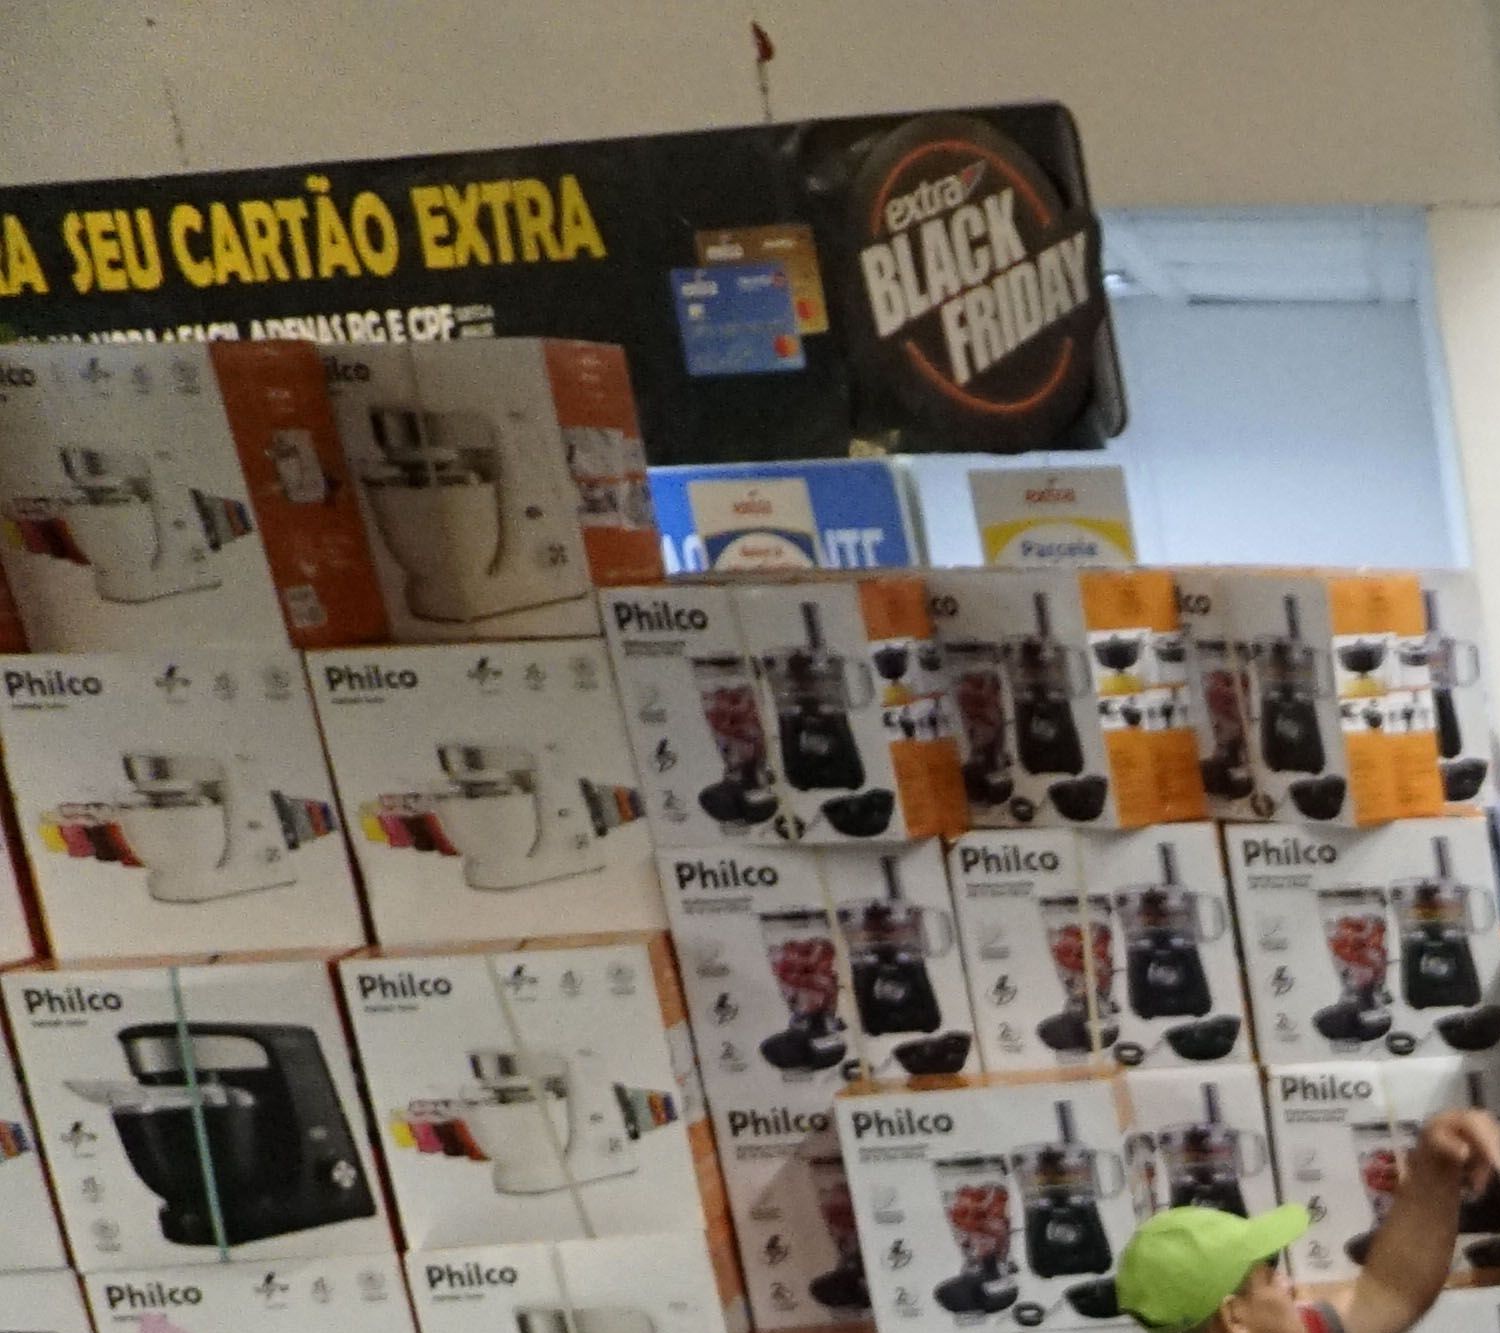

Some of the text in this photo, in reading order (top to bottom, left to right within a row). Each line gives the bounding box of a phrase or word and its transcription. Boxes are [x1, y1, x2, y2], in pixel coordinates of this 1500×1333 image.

[884, 172, 966, 233] extra
[63, 207, 164, 294] SEU
[169, 173, 400, 288] CARTÃO
[410, 173, 607, 269] EXTRA
[860, 189, 1027, 339] BLACK
[408, 304, 455, 344] CPF
[941, 231, 1090, 386] FRIDAY
[614, 602, 709, 635] Philco
[4, 667, 103, 700] Philco
[324, 661, 419, 696] Philco
[958, 843, 1060, 876] Philco
[1239, 837, 1338, 868] Philco
[674, 857, 781, 893] Philco
[23, 986, 124, 1017] Philco
[357, 969, 453, 1002] Philco
[1279, 1071, 1374, 1104] Philco
[726, 1106, 831, 1138] Philco
[851, 1106, 956, 1138] Philco
[424, 1258, 519, 1291] Philco
[105, 1279, 204, 1312] Philco
